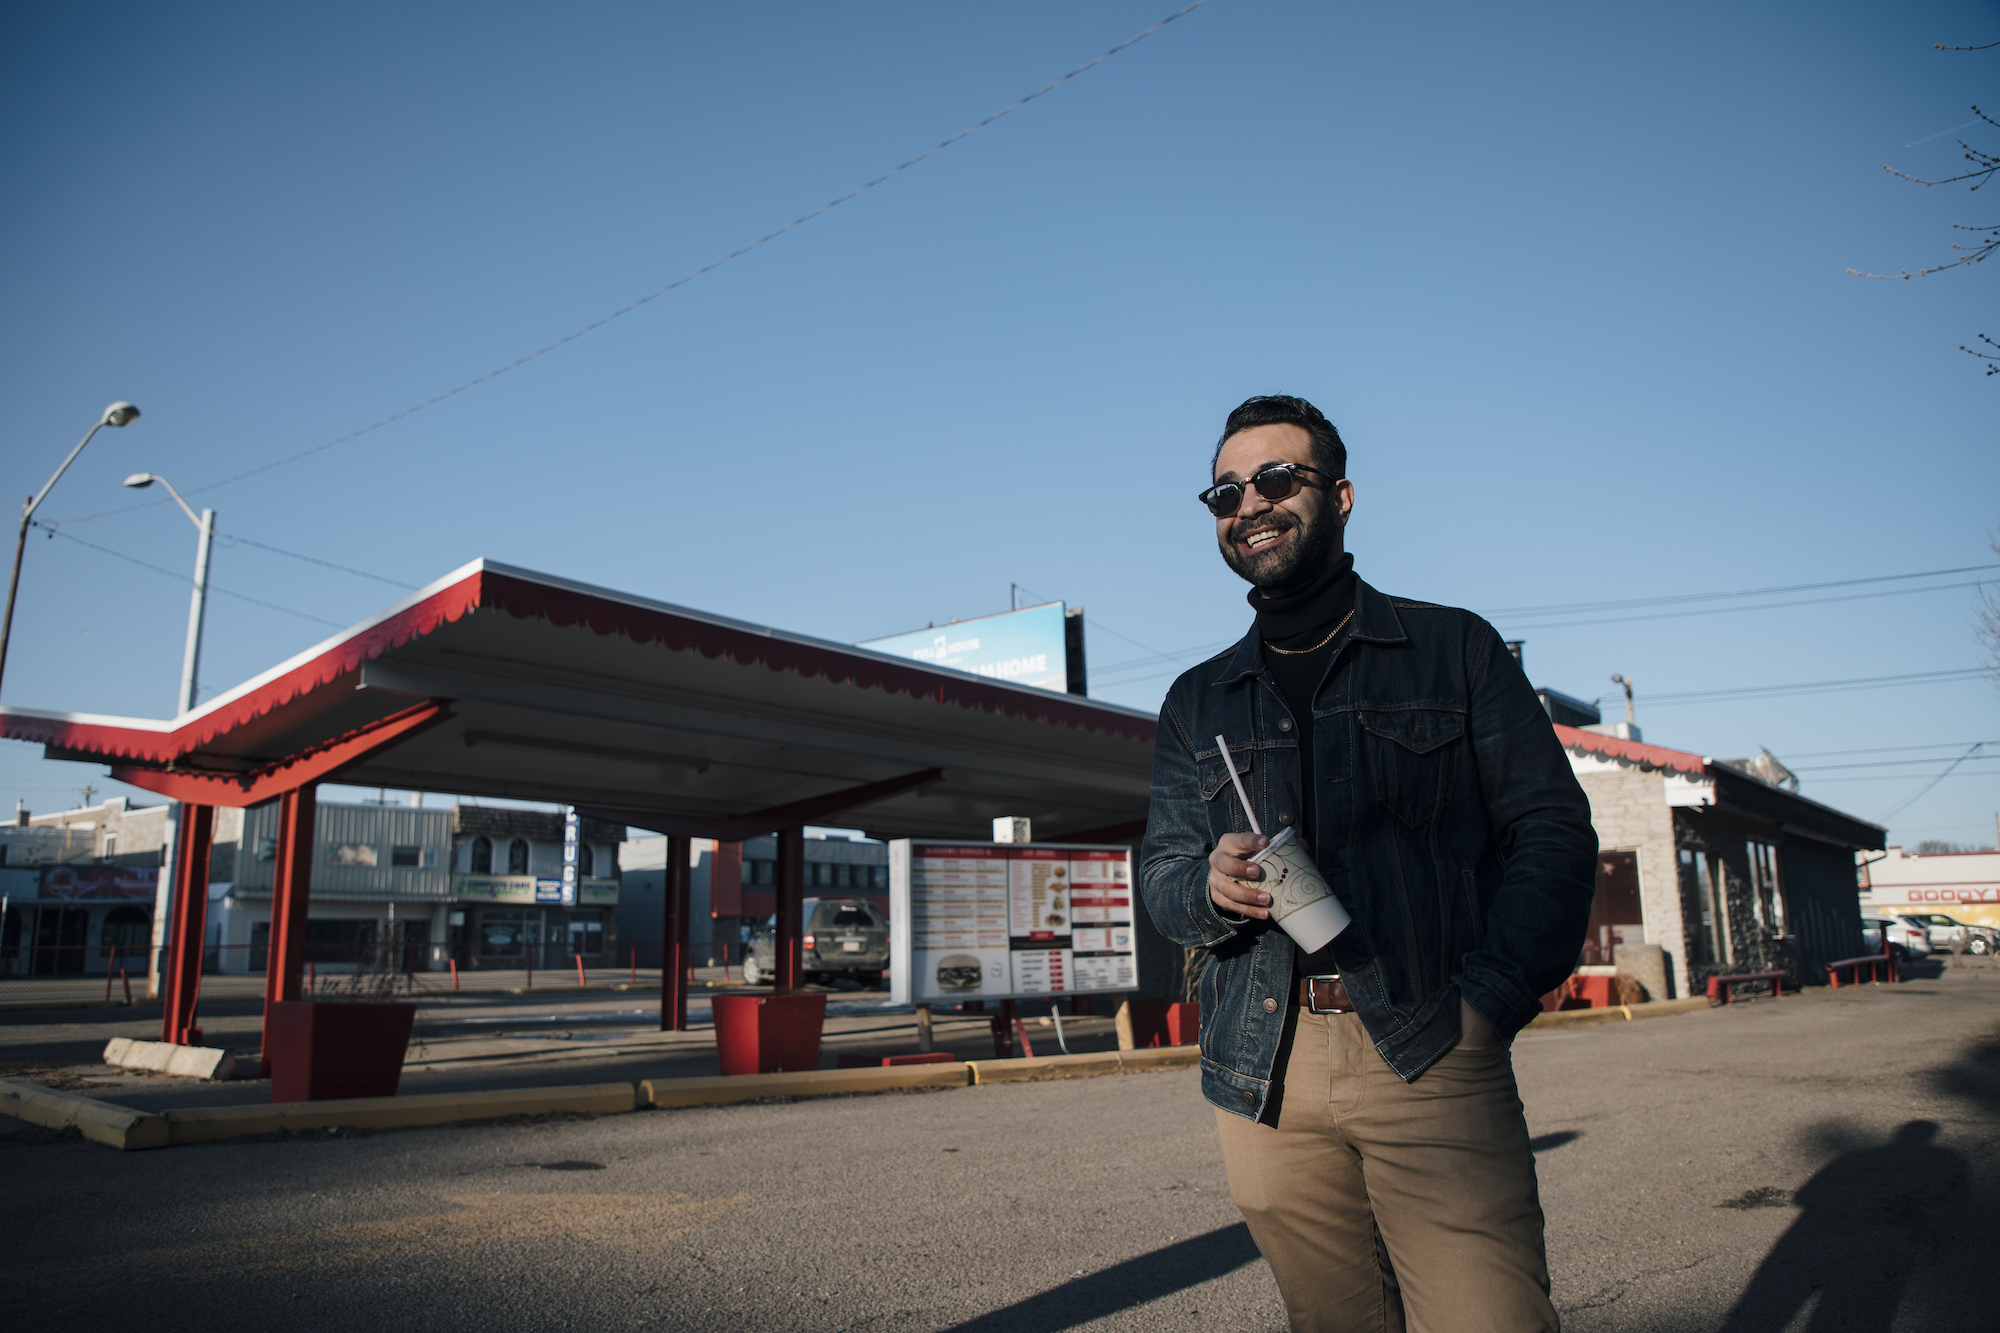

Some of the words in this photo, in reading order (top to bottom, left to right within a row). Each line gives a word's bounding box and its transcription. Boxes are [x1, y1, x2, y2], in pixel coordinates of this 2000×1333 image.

[947, 638, 980, 653] HOUSE
[996, 653, 1047, 679] HOME
[562, 805, 577, 901] DRUGS
[1908, 888, 1989, 901] GOODY
